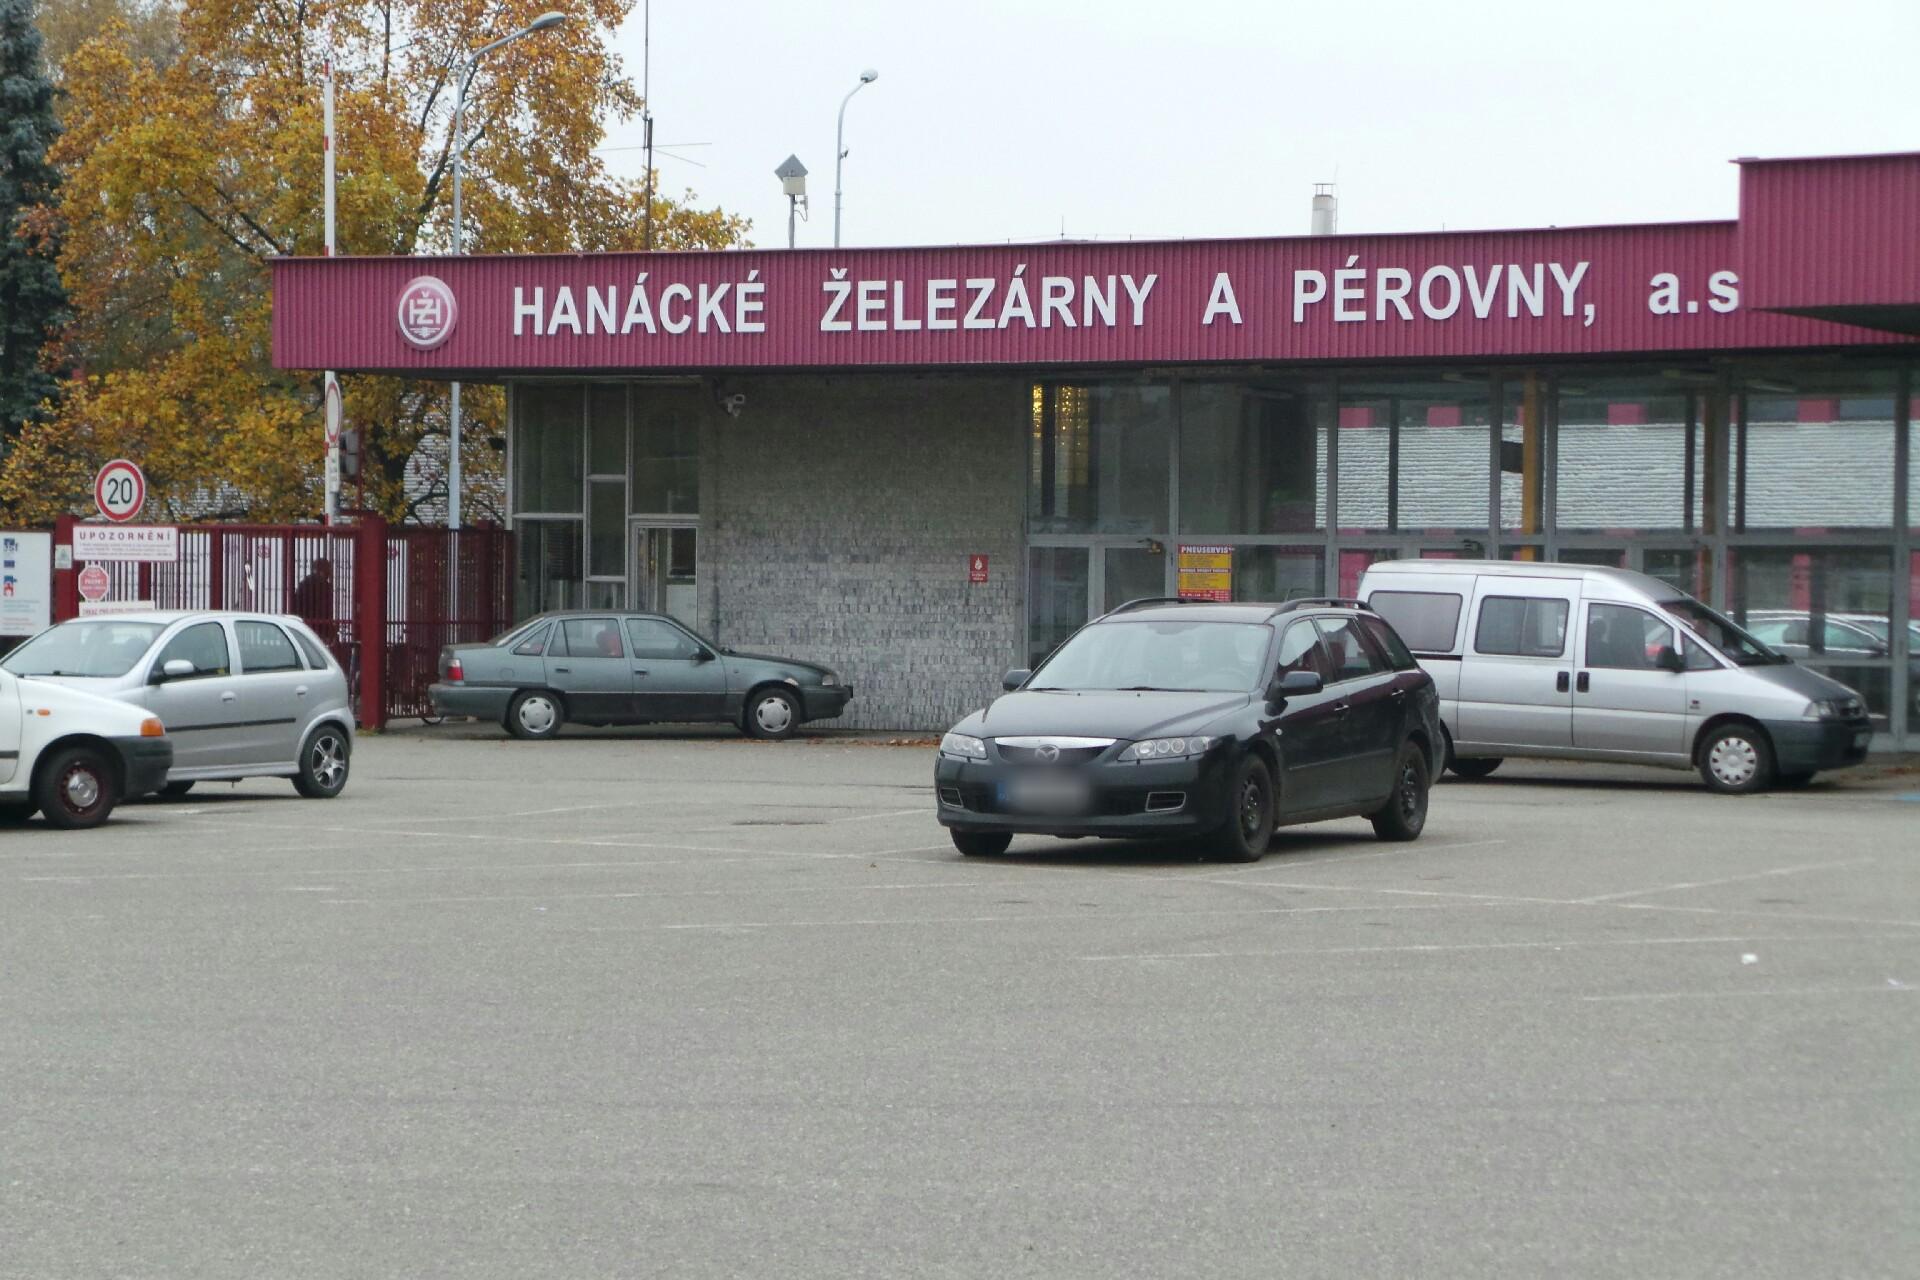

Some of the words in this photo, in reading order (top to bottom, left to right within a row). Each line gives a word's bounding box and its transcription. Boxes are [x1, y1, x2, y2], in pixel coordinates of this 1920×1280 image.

[513, 269, 766, 336] HANÁCKÉ
[820, 264, 1158, 332] ŽELEZÁRNY
[1202, 272, 1243, 325] A
[1293, 255, 1595, 327] PÉROVNY,
[1648, 270, 1739, 315] a.s
[107, 477, 133, 505] 20
[79, 530, 171, 541] UPOZORNĚNÍ
